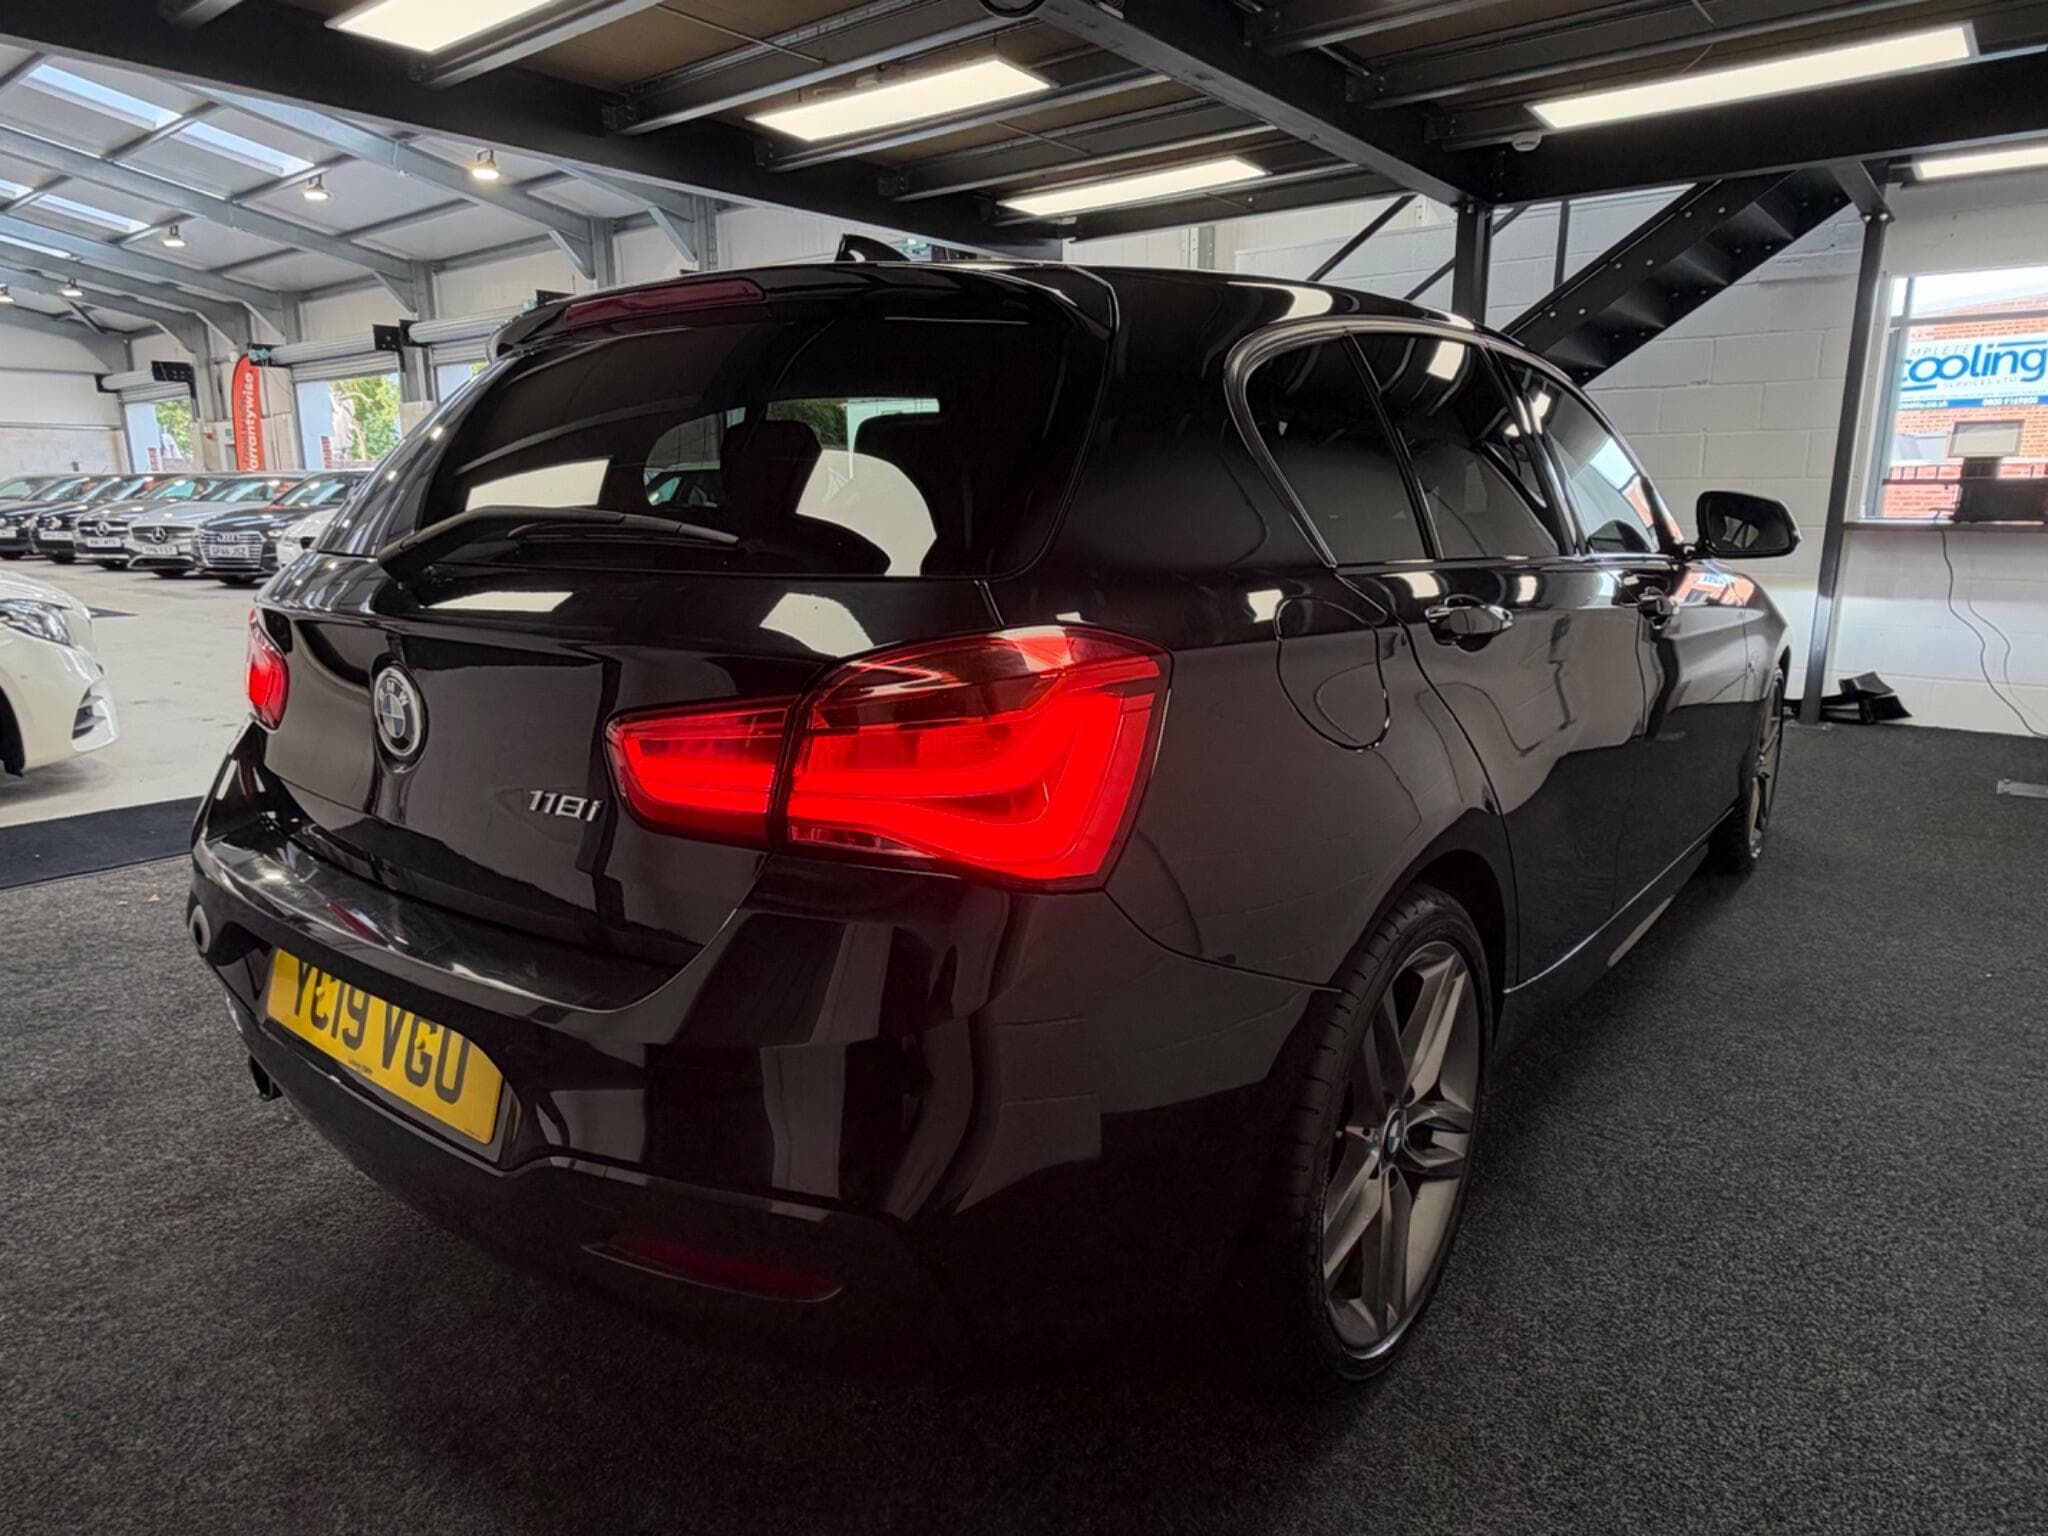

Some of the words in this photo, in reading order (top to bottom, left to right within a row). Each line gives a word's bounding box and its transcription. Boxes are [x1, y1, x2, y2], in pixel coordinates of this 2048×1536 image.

[1910, 344, 1970, 356] MPLETE
[529, 789, 602, 822] 118i
[294, 959, 371, 1051] YC19
[381, 1002, 470, 1105] VGU
